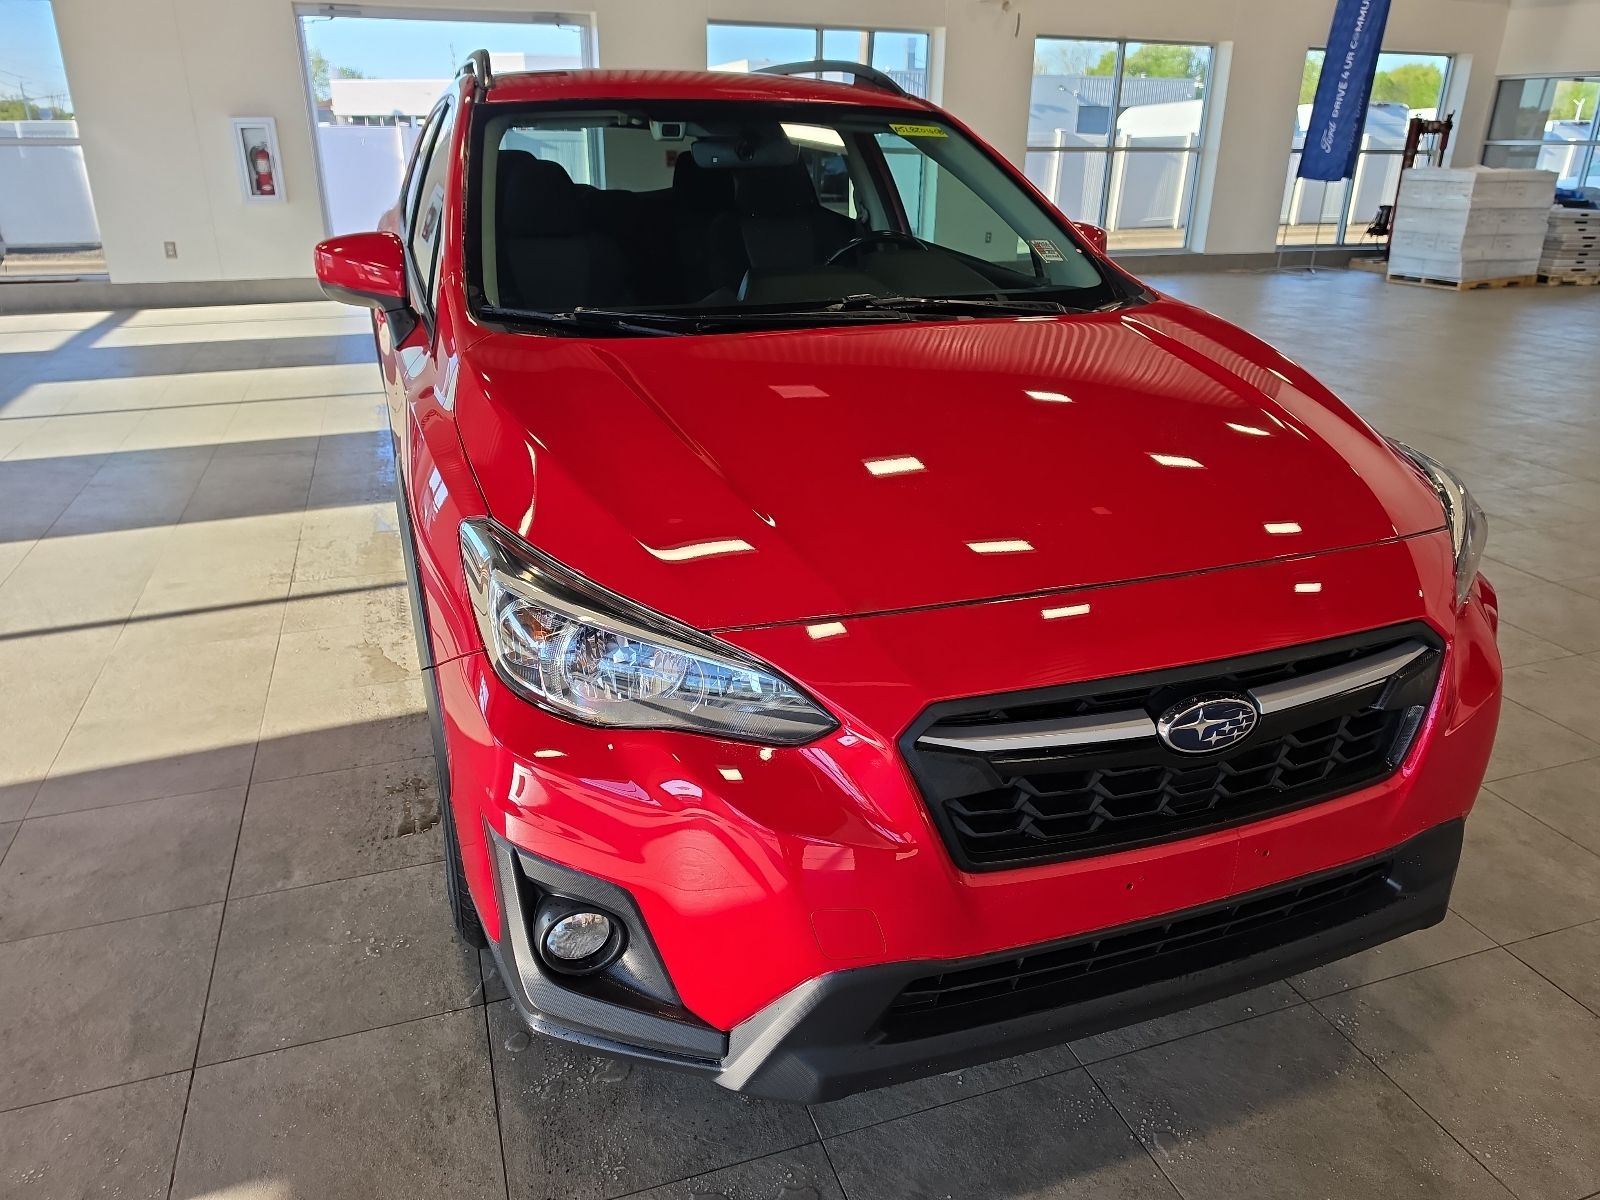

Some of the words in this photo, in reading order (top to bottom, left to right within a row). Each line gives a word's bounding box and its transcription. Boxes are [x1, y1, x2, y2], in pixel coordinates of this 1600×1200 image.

[1343, 51, 1355, 70] UR
[1341, 70, 1350, 80] 4
[1331, 80, 1348, 118] DRIVE
[1320, 120, 1337, 154] Ford
